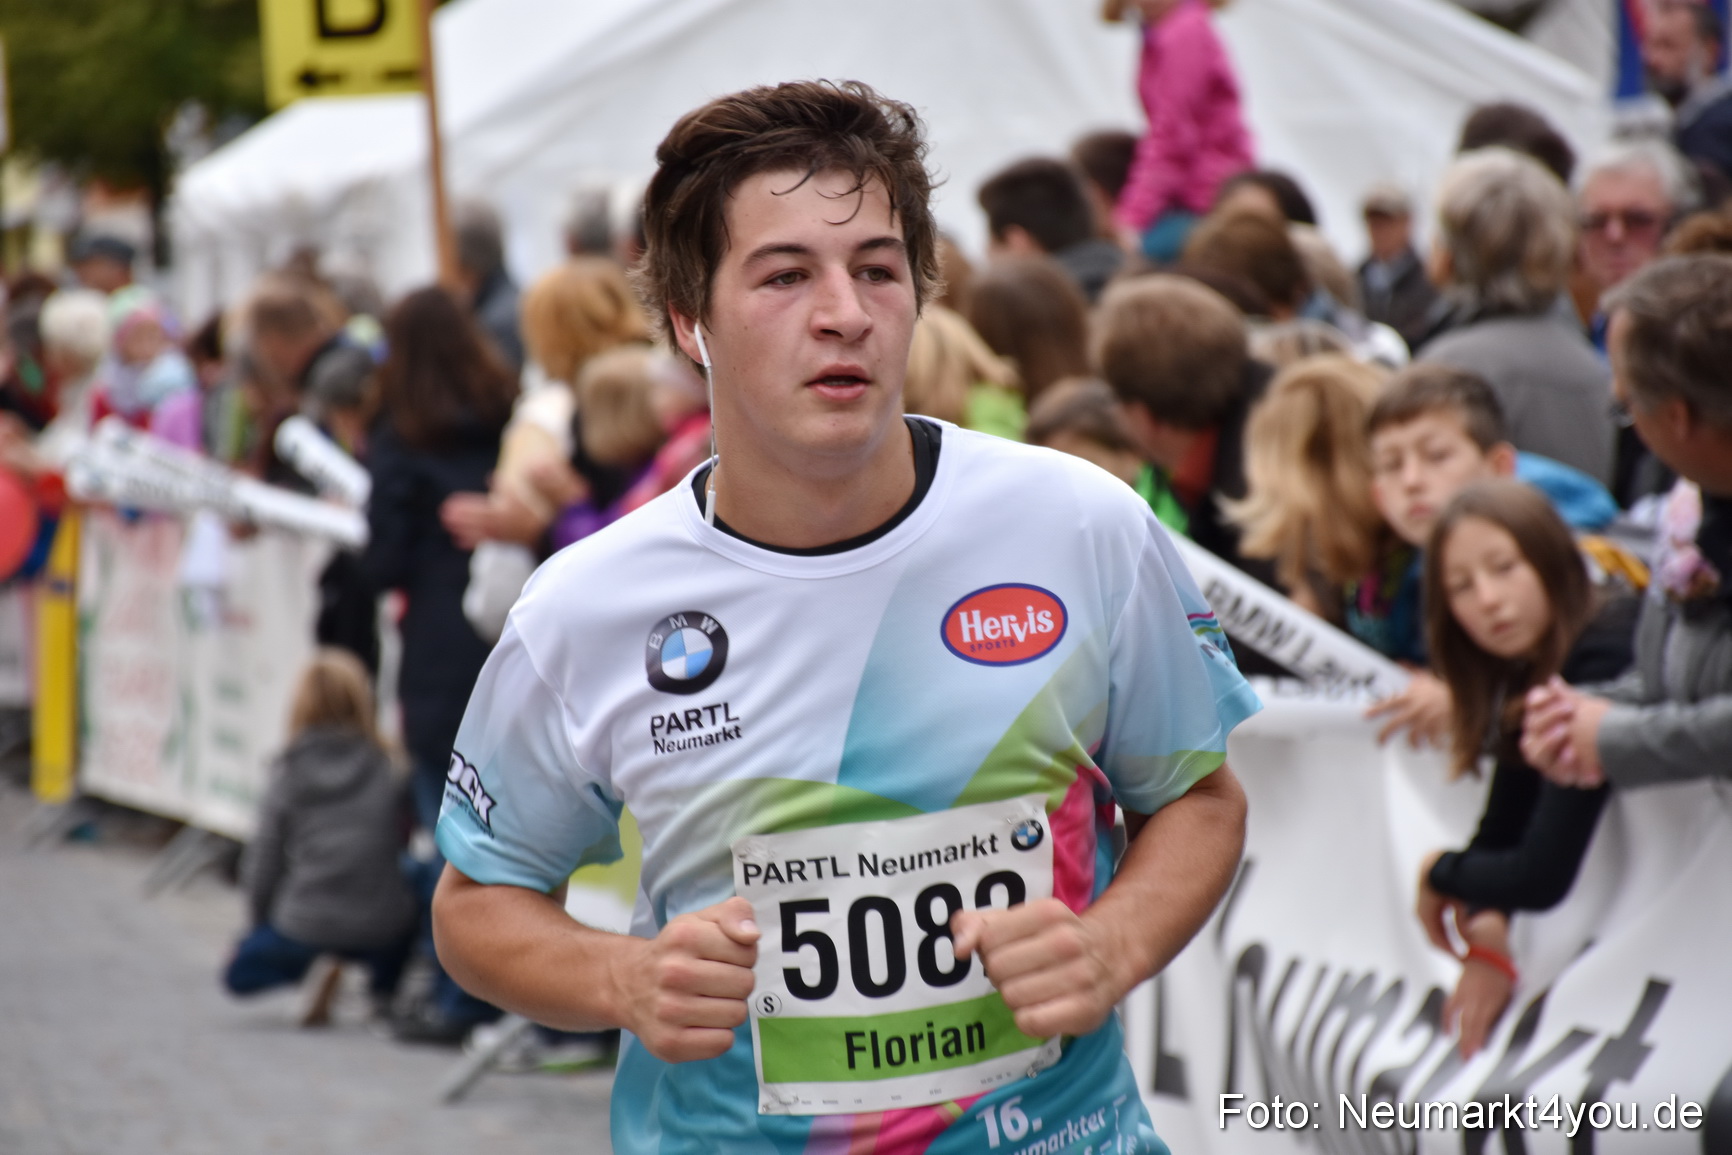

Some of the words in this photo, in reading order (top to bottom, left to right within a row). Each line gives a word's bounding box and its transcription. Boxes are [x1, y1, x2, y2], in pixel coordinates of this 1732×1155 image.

[648, 614, 720, 650] BMW
[958, 605, 1054, 643] Hervis
[969, 639, 1016, 653] SPORTS
[650, 702, 740, 737] PARTL
[653, 725, 742, 755] Neumarkt
[742, 856, 850, 886] PARTL
[857, 833, 999, 878] Neumarkt
[844, 1020, 986, 1070] Florian
[976, 1096, 1043, 1149] 16.
